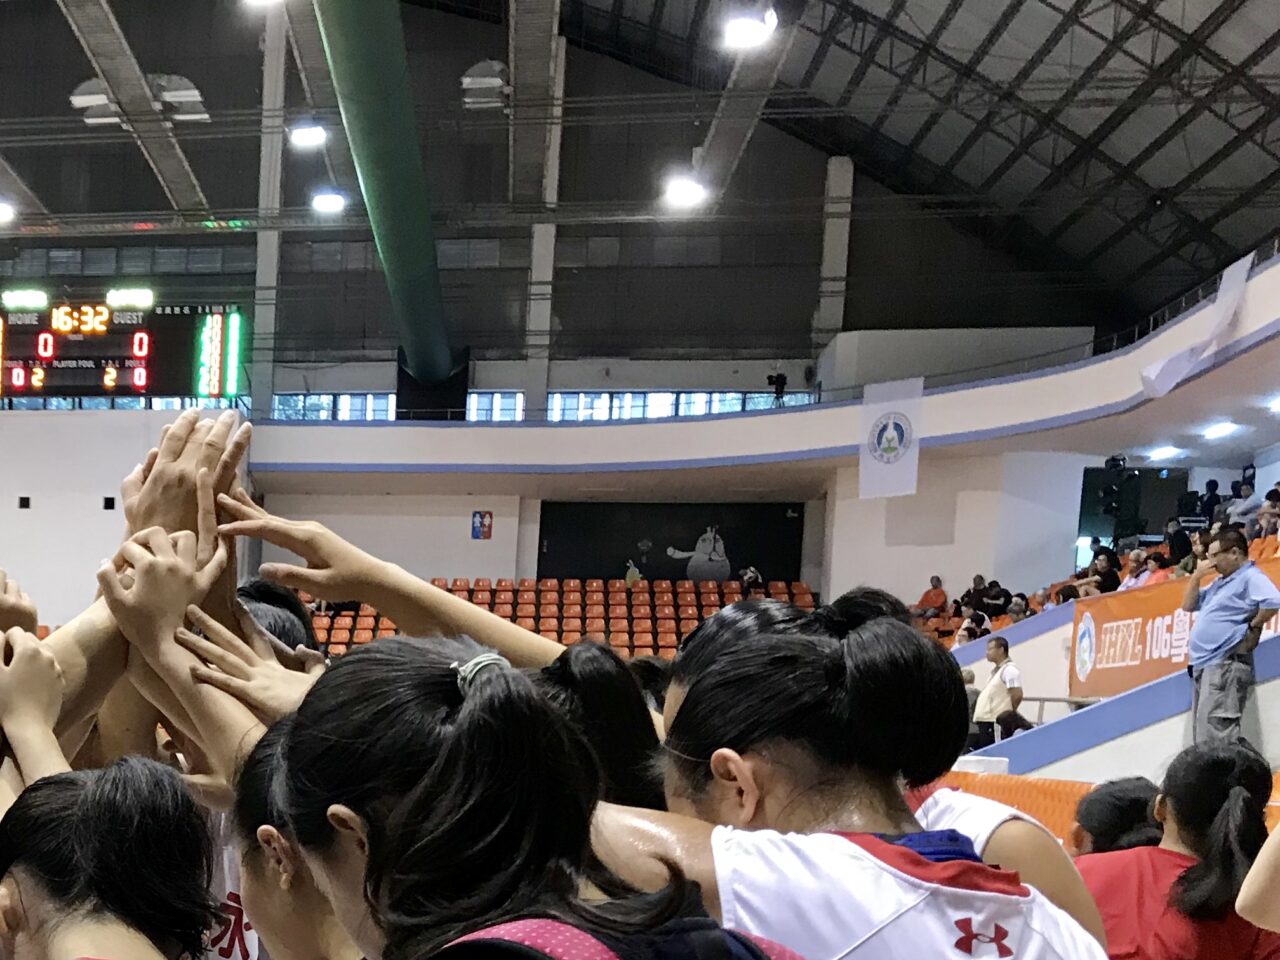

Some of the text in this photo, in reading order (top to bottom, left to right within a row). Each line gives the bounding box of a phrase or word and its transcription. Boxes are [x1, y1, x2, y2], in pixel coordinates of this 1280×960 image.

[8, 313, 39, 325] HOME
[52, 306, 109, 331] 16:32
[112, 312, 144, 324] GUEST
[38, 333, 53, 357] 0
[133, 332, 148, 357] 0
[12, 368, 25, 386] 0
[31, 368, 44, 387] 2
[104, 368, 117, 387] 2
[133, 368, 147, 386] 0
[1145, 607, 1198, 664] 106學
